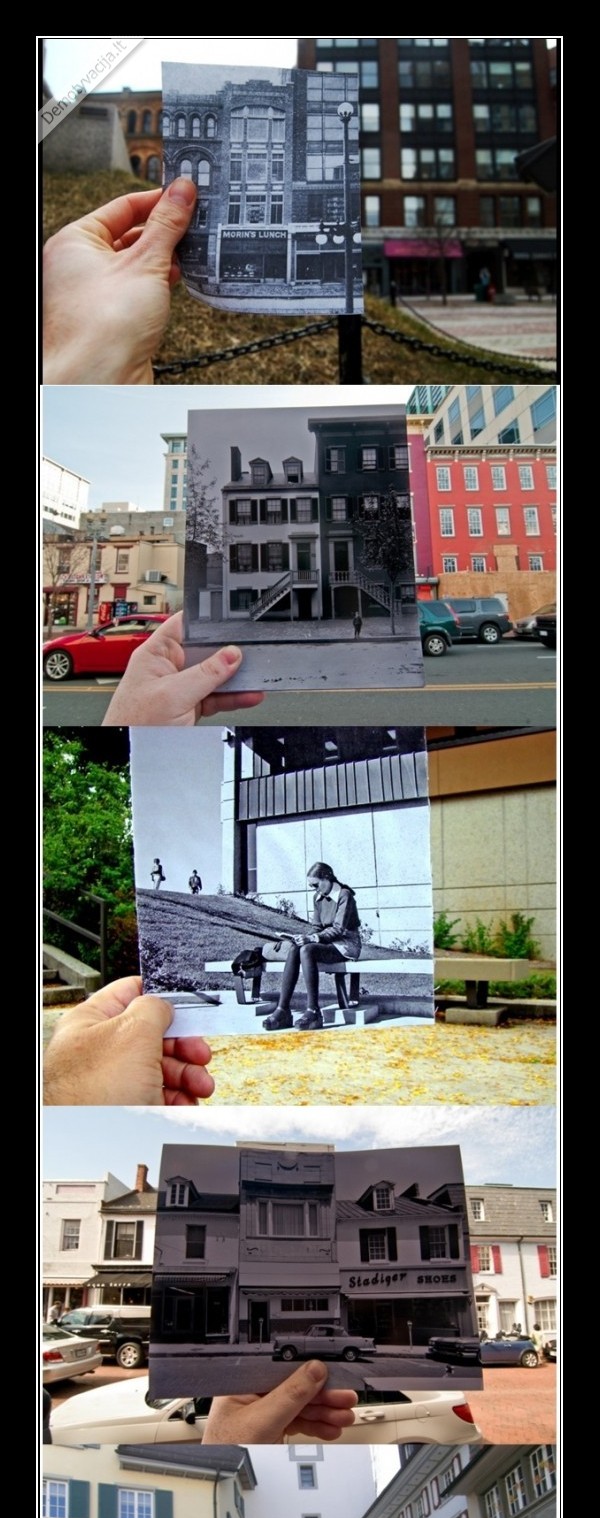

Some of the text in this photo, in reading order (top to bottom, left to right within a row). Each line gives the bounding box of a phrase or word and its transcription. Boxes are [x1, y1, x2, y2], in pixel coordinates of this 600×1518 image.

[222, 231, 287, 239] MORIN'S LUNCH
[348, 1272, 457, 1288] Stadiger SHOES
